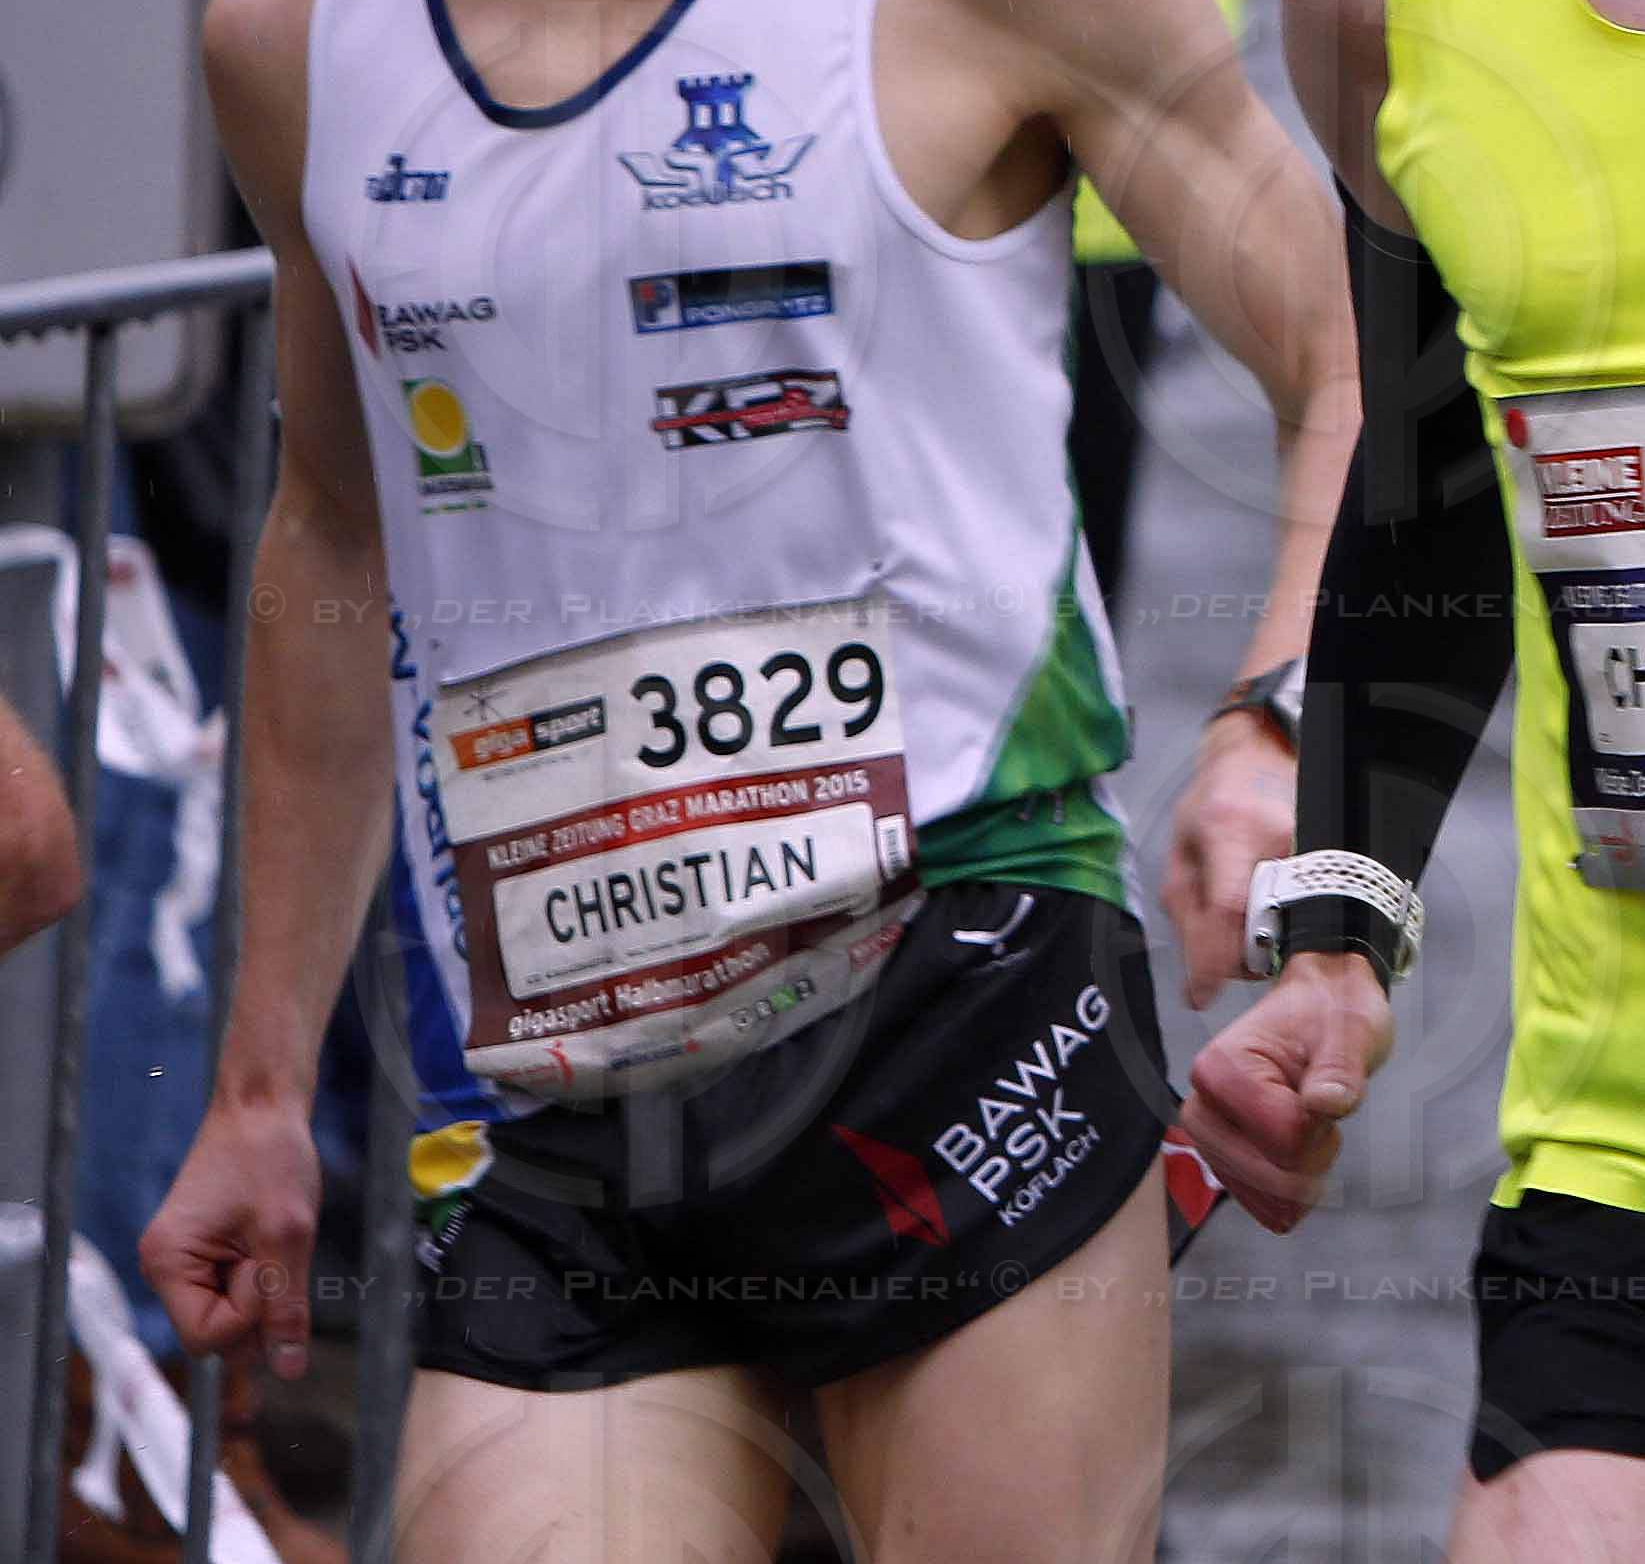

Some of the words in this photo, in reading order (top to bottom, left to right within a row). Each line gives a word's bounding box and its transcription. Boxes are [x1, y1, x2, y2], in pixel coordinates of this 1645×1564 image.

[630, 642, 884, 768] 3829
[627, 802, 681, 833] GRAZ
[684, 778, 810, 820] MARATHON
[813, 768, 871, 802] 2015
[545, 836, 818, 945] CHRISTIAN
[507, 992, 613, 1039] gigasport
[933, 984, 1111, 1174] BAWAG
[968, 1086, 1086, 1204] PSK
